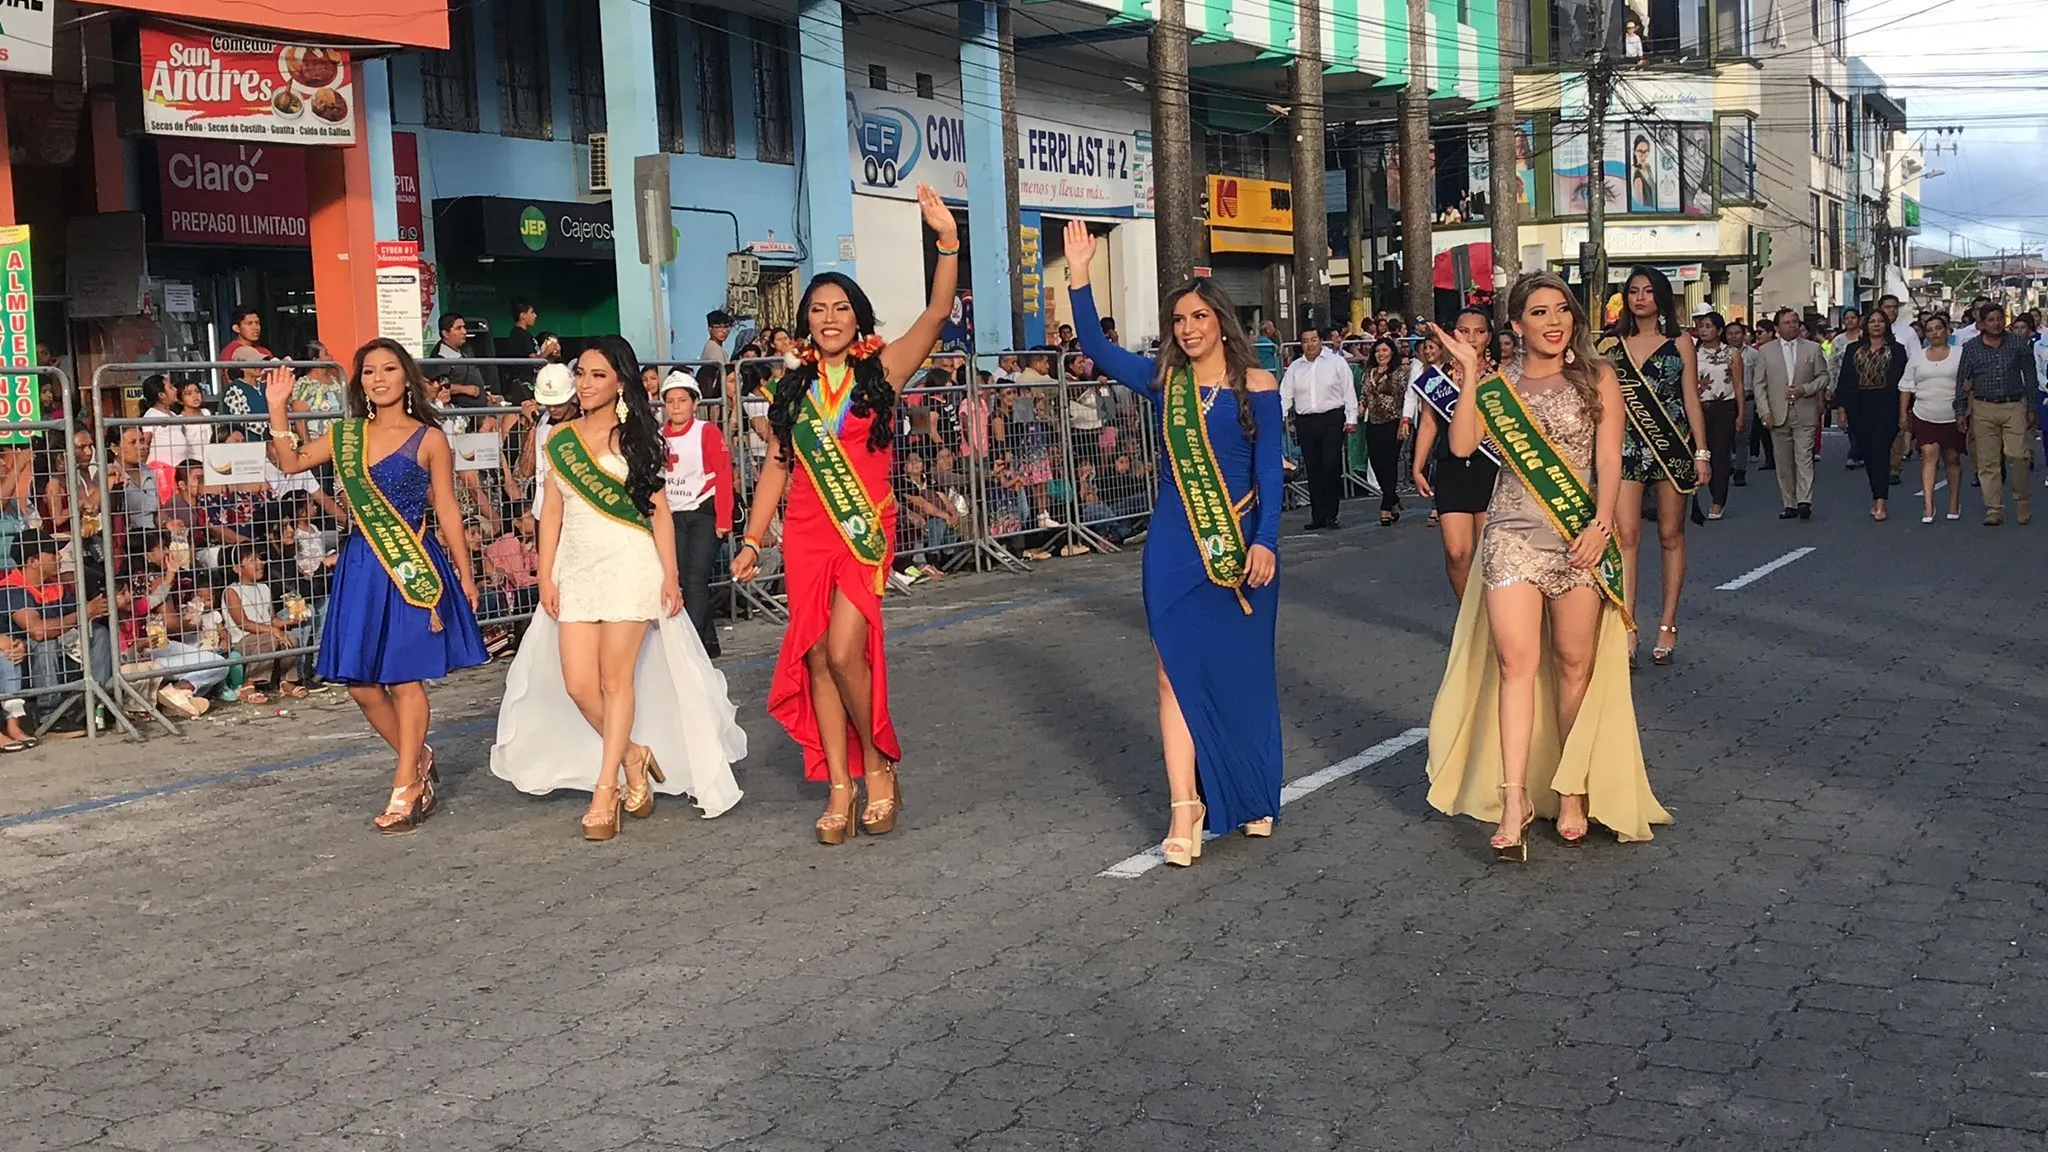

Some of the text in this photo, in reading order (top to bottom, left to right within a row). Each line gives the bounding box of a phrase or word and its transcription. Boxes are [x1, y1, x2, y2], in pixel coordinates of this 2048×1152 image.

[169, 42, 212, 67] San
[150, 59, 272, 102] Andres
[151, 120, 173, 131] Secos
[174, 121, 184, 131] de
[208, 123, 229, 133] Secos
[230, 124, 239, 133] de
[319, 128, 328, 136] de
[864, 122, 896, 154] CF
[168, 151, 254, 193] Claro
[1029, 129, 1103, 177] FERPLAST
[1050, 184, 1056, 201] y
[172, 210, 306, 237] PREPAGO ILIMITADO
[520, 219, 546, 235] JEP
[560, 215, 616, 242] Cajeros
[381, 246, 403, 254] CYBER
[1480, 390, 1543, 471] Candidata
[821, 468, 852, 514] PASTAZA
[827, 451, 841, 463] DE
[840, 474, 877, 528] PROVINCI
[1180, 459, 1194, 474] DE
[1187, 480, 1212, 528] PASTAZA
[1185, 428, 1205, 463] REINA
[1197, 464, 1208, 477] DE
[1205, 490, 1237, 552] PROVINCIA
[1545, 465, 1577, 498] REINA
[1570, 496, 1585, 508] DE
[1550, 496, 1571, 512] DE
[361, 503, 376, 518] DE
[371, 521, 402, 560] PASTAZA
[390, 525, 429, 575] PROVINCIA
